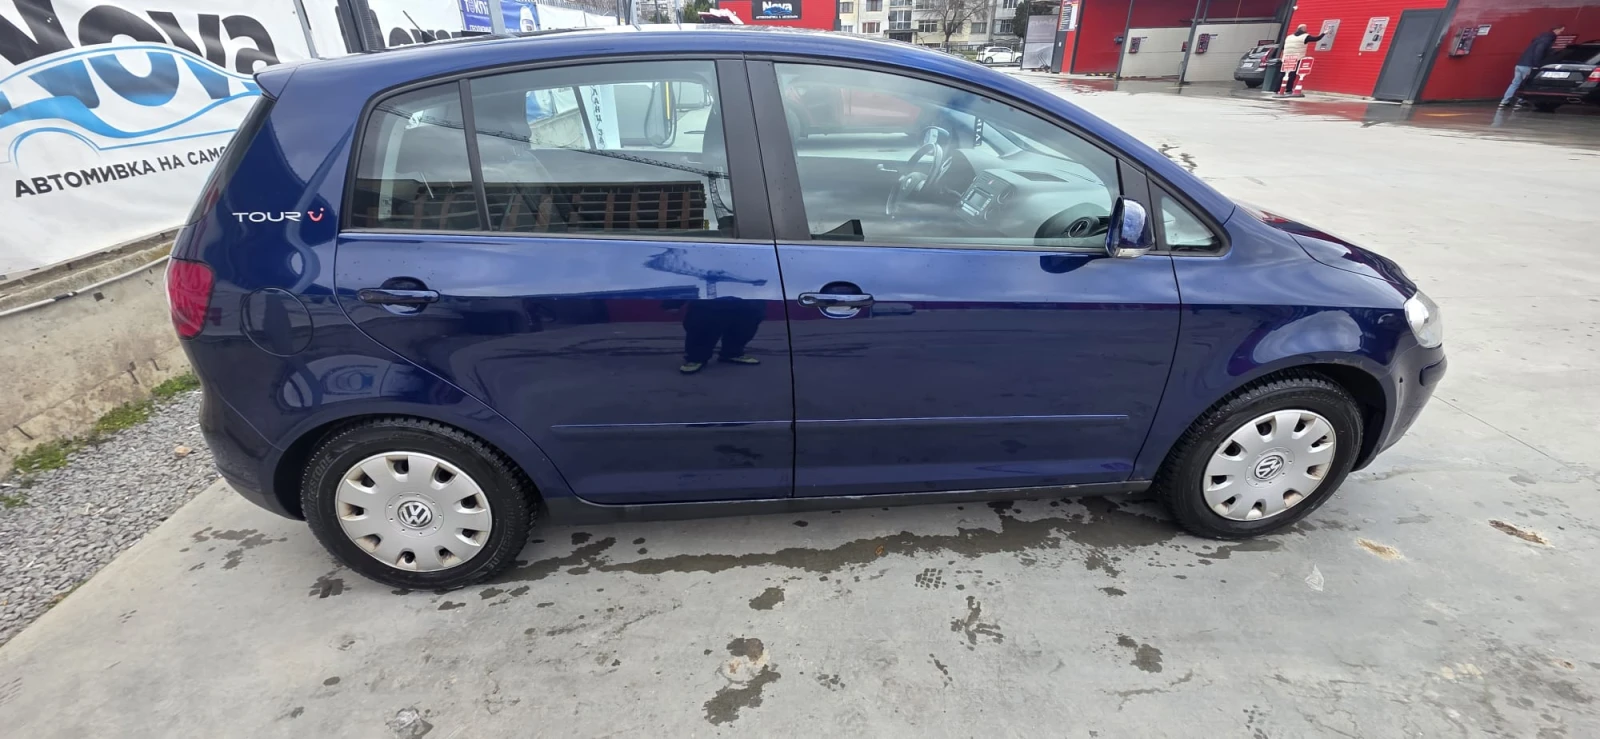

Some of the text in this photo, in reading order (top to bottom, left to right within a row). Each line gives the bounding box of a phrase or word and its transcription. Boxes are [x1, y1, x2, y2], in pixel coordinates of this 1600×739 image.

[15, 159, 156, 198] АВТОМИВКА
[157, 154, 185, 172] НА
[232, 211, 301, 222] TOUR
